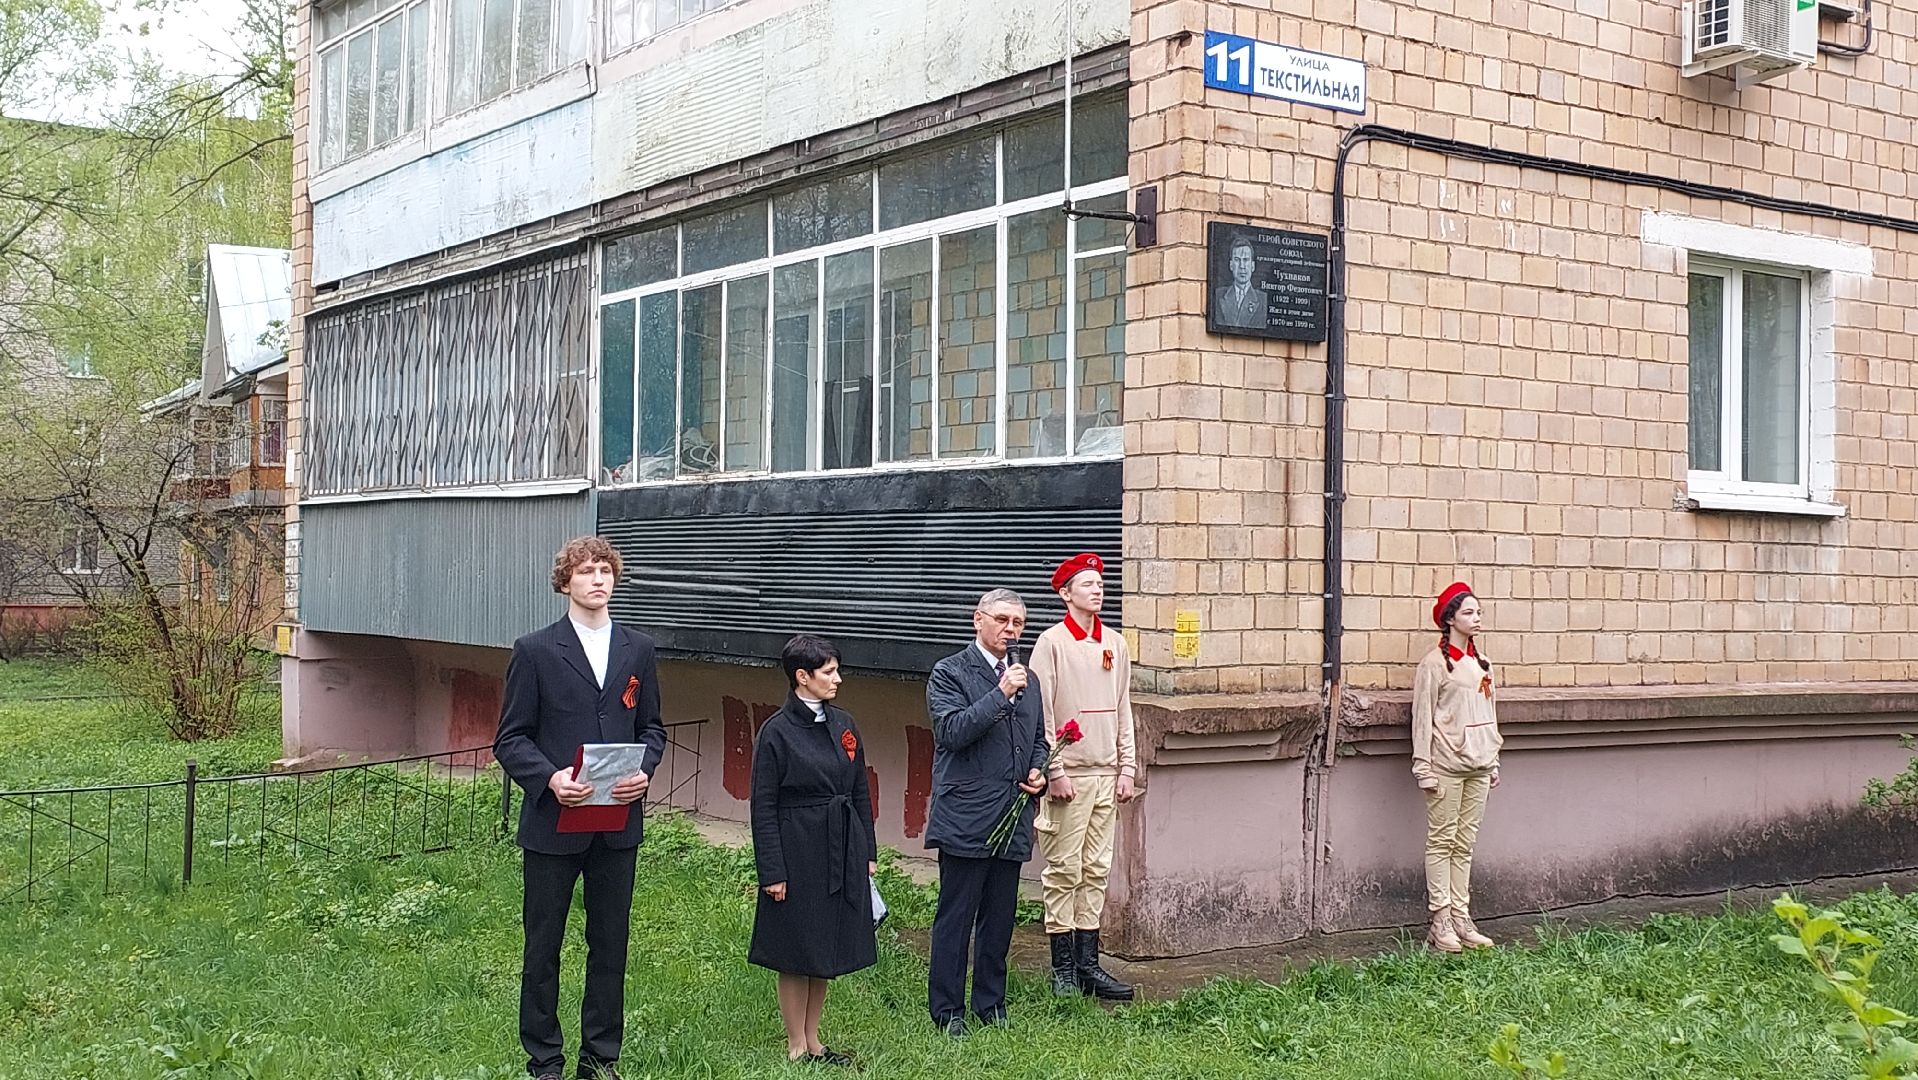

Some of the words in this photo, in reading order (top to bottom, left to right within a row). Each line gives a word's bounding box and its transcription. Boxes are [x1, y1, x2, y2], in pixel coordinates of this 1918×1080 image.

[1205, 40, 1251, 86] 11
[1289, 54, 1331, 72] УЛИЦА
[1260, 67, 1360, 103] ТЕКСТИЛЬНАЯ
[1258, 234, 1281, 245] ГЕРОЙ
[1281, 237, 1325, 249] СОВЕТСКОГО
[1279, 248, 1304, 259] СОЮЗА
[1261, 280, 1286, 293] Виктор
[1286, 283, 1323, 296] Федотович
[1272, 317, 1286, 326] 1970
[1294, 320, 1308, 328] 1999
